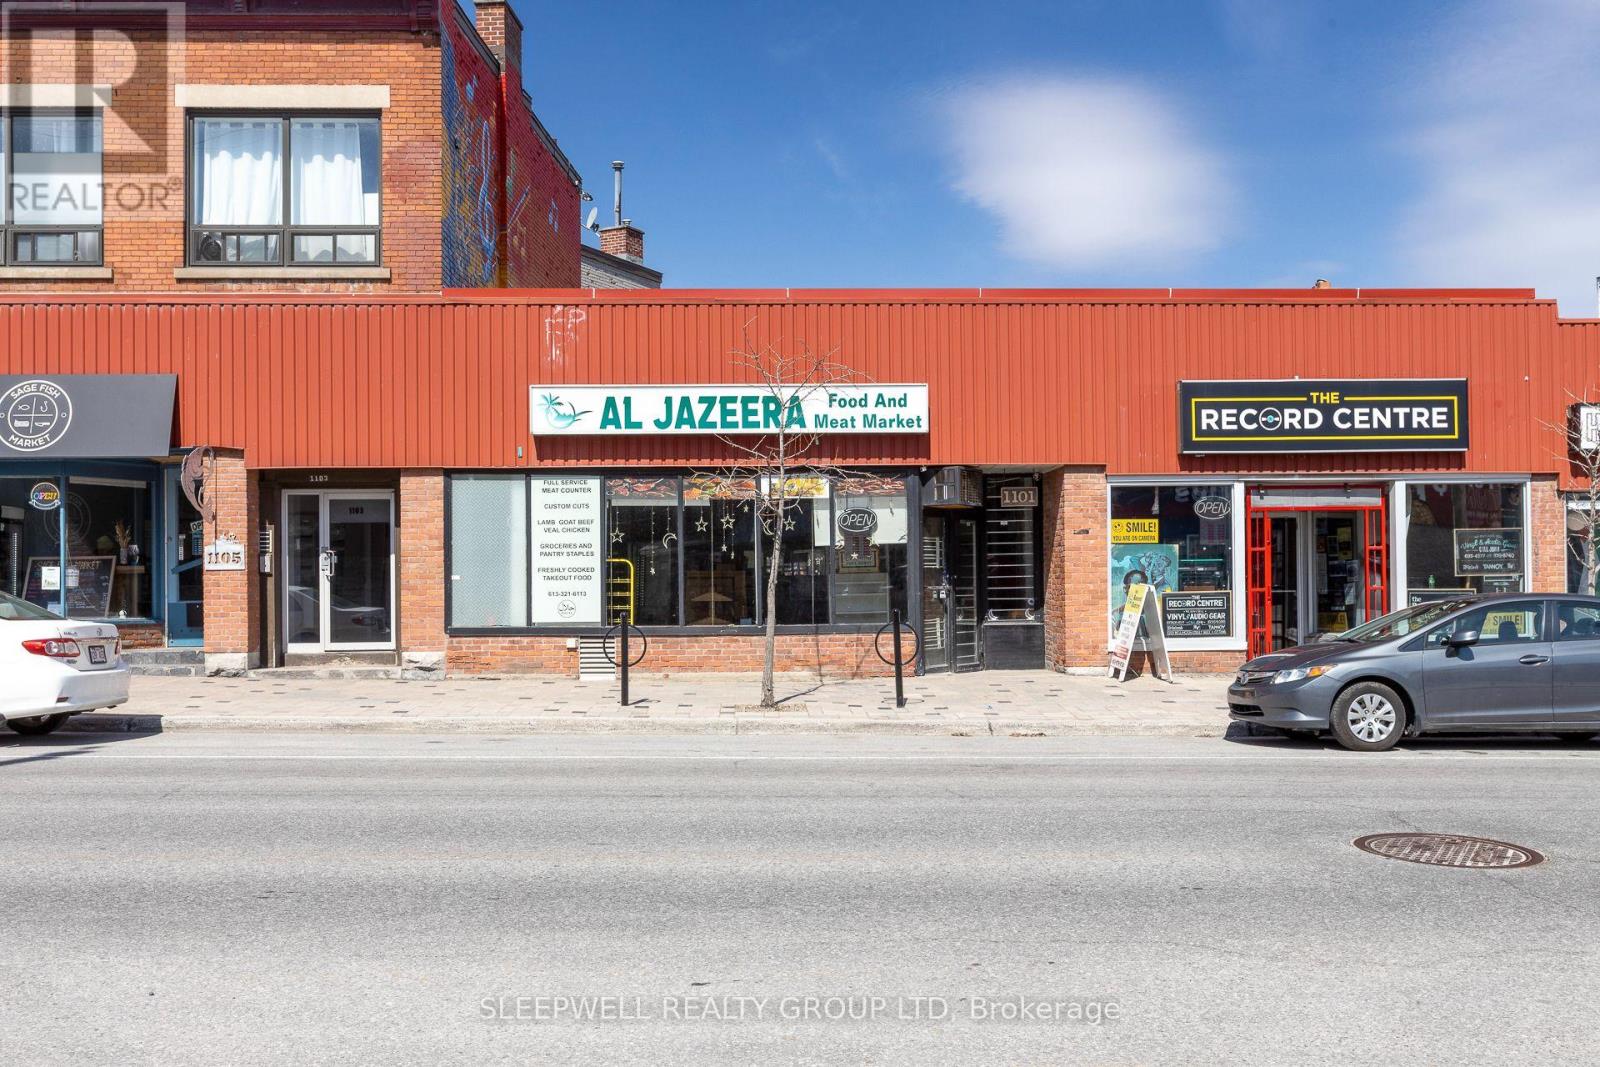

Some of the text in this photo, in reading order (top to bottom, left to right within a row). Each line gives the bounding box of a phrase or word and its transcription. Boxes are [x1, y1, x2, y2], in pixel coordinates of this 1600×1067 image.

[10, 384, 61, 399] SAGE FISH
[1310, 392, 1340, 404] THE
[828, 393, 907, 408] Food And
[599, 395, 807, 430] AL JAZEERA
[1201, 407, 1449, 431] RECORD CENTRE
[814, 413, 922, 428] Meat Market
[8, 433, 51, 447] MARKET
[1004, 490, 1034, 502] 1101
[1197, 501, 1228, 514] OPEN
[840, 513, 873, 526] OPEN
[1126, 521, 1157, 533] SMILE!
[208, 551, 241, 564] 1105
[1197, 599, 1223, 607] CENTRE
